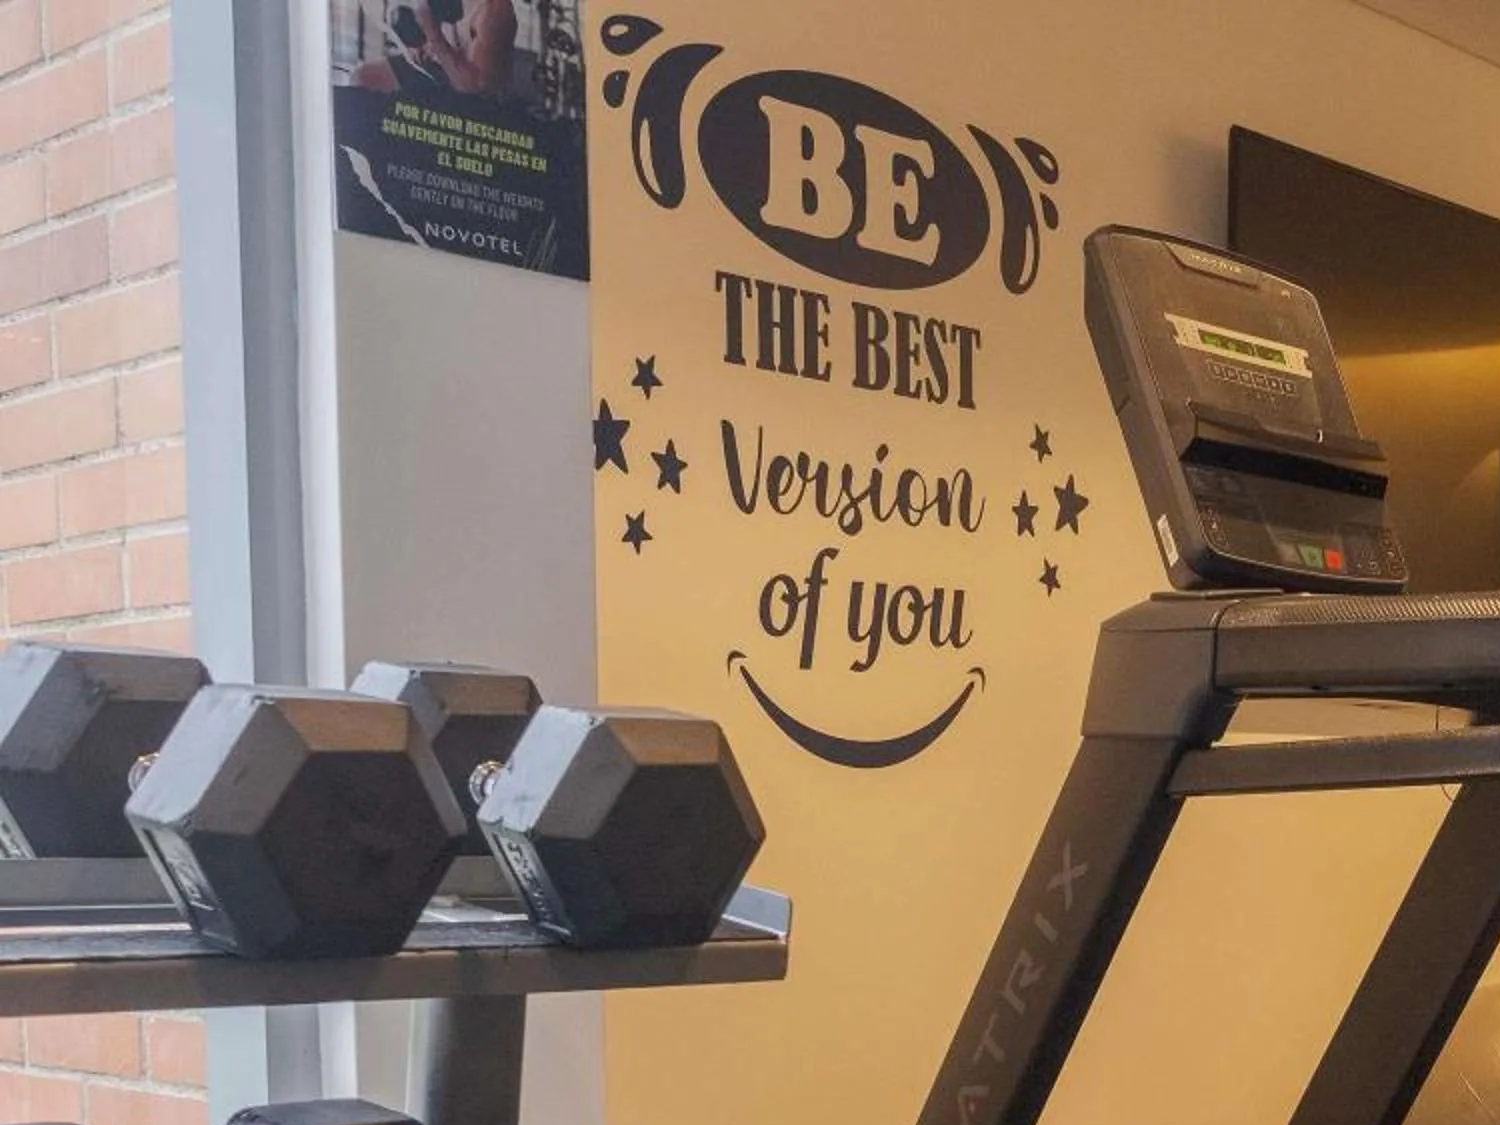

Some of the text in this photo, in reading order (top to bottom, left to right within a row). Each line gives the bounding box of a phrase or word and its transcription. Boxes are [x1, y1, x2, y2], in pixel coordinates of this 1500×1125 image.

[382, 117, 548, 173] SUAVEMENTE LAS PESAS EN
[395, 101, 535, 149] POR FAVOR DESCARGAR
[437, 151, 494, 177] EL SUELO
[758, 95, 941, 266] BE
[425, 221, 524, 256] NOVOTEL
[715, 270, 981, 409] THE BEST
[721, 419, 986, 536] Version
[758, 547, 974, 673] of you
